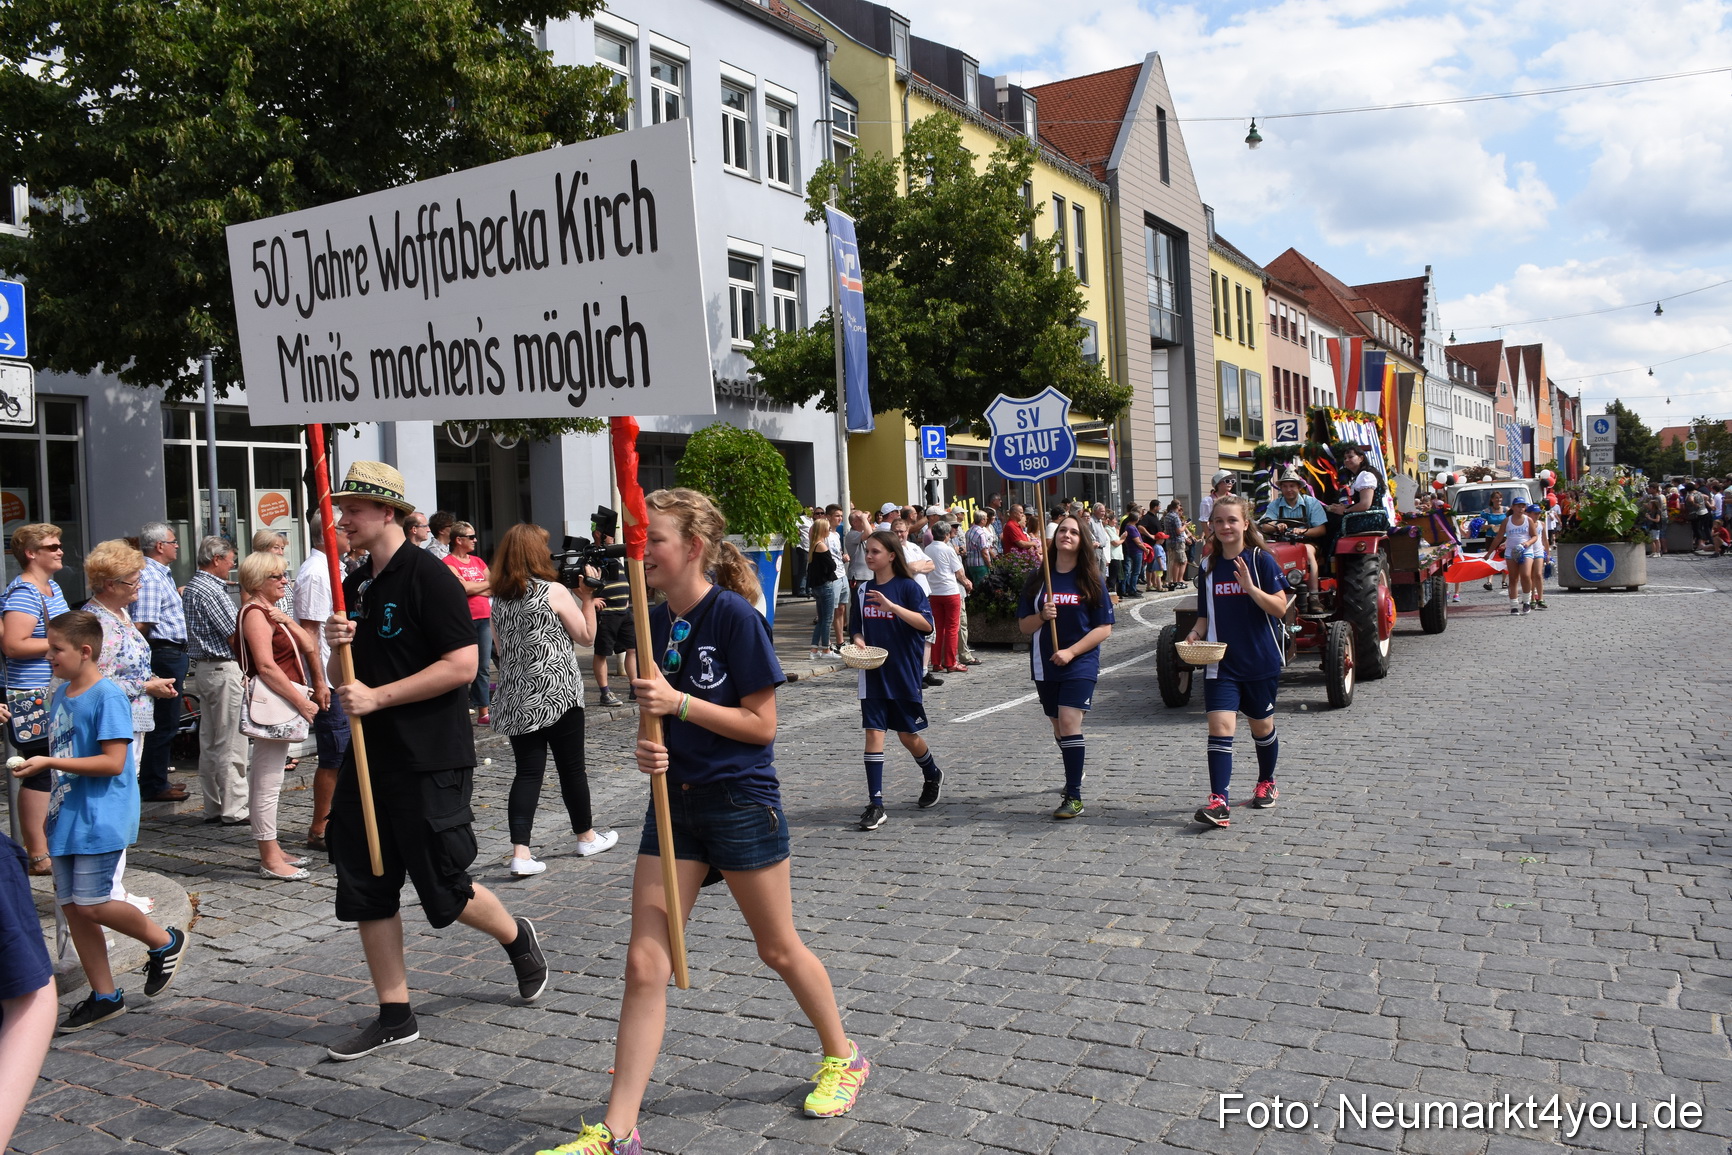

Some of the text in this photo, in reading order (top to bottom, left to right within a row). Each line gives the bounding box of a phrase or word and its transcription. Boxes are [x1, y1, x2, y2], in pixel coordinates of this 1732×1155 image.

[252, 159, 658, 319] 50 Jahre Woffabecka Kirch
[277, 295, 650, 408] Mini's machen's möglich
[1016, 406, 1040, 430] SV
[927, 430, 940, 455] P
[1003, 429, 1060, 457] STAUF
[1018, 455, 1050, 471] 1980
[1215, 582, 1248, 595] REW
